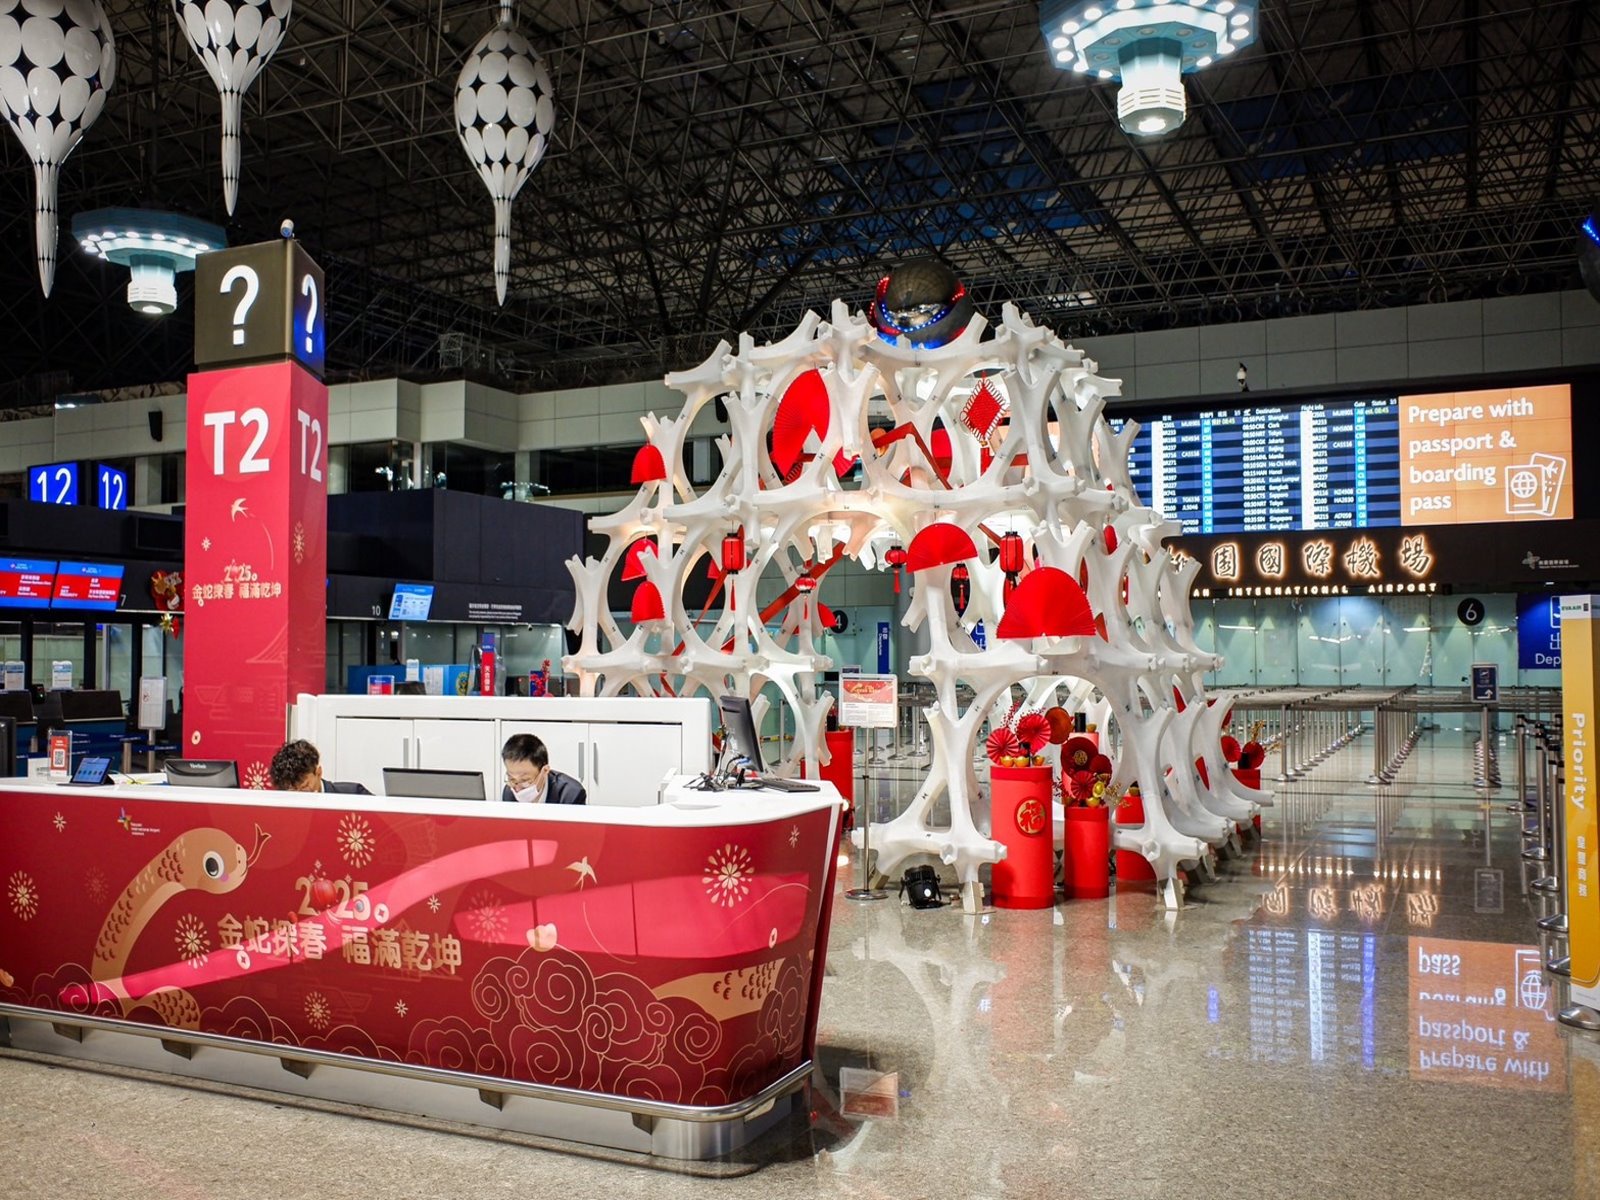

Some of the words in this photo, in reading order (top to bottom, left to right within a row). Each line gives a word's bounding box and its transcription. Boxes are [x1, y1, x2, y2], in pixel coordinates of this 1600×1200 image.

[1408, 403, 1484, 427] Prepare
[1490, 397, 1534, 418] with
[204, 407, 270, 475] T2
[298, 408, 322, 483] T2
[1409, 432, 1494, 459] passport
[1499, 430, 1517, 448] &
[37, 467, 72, 505] 12
[1409, 463, 1497, 485] boarding
[102, 471, 123, 510] 12
[1410, 494, 1452, 516] pass
[121, 594, 127, 607] 7
[1228, 585, 1349, 597] INTERNATIONAL
[1368, 582, 1437, 594] AIRPORT
[372, 605, 381, 616] 10
[835, 615, 842, 629] 4
[1466, 602, 1478, 621] 6
[1571, 712, 1587, 810] Priority
[217, 912, 327, 960] 金蛇探春
[341, 924, 462, 975] 福滿乾坤
